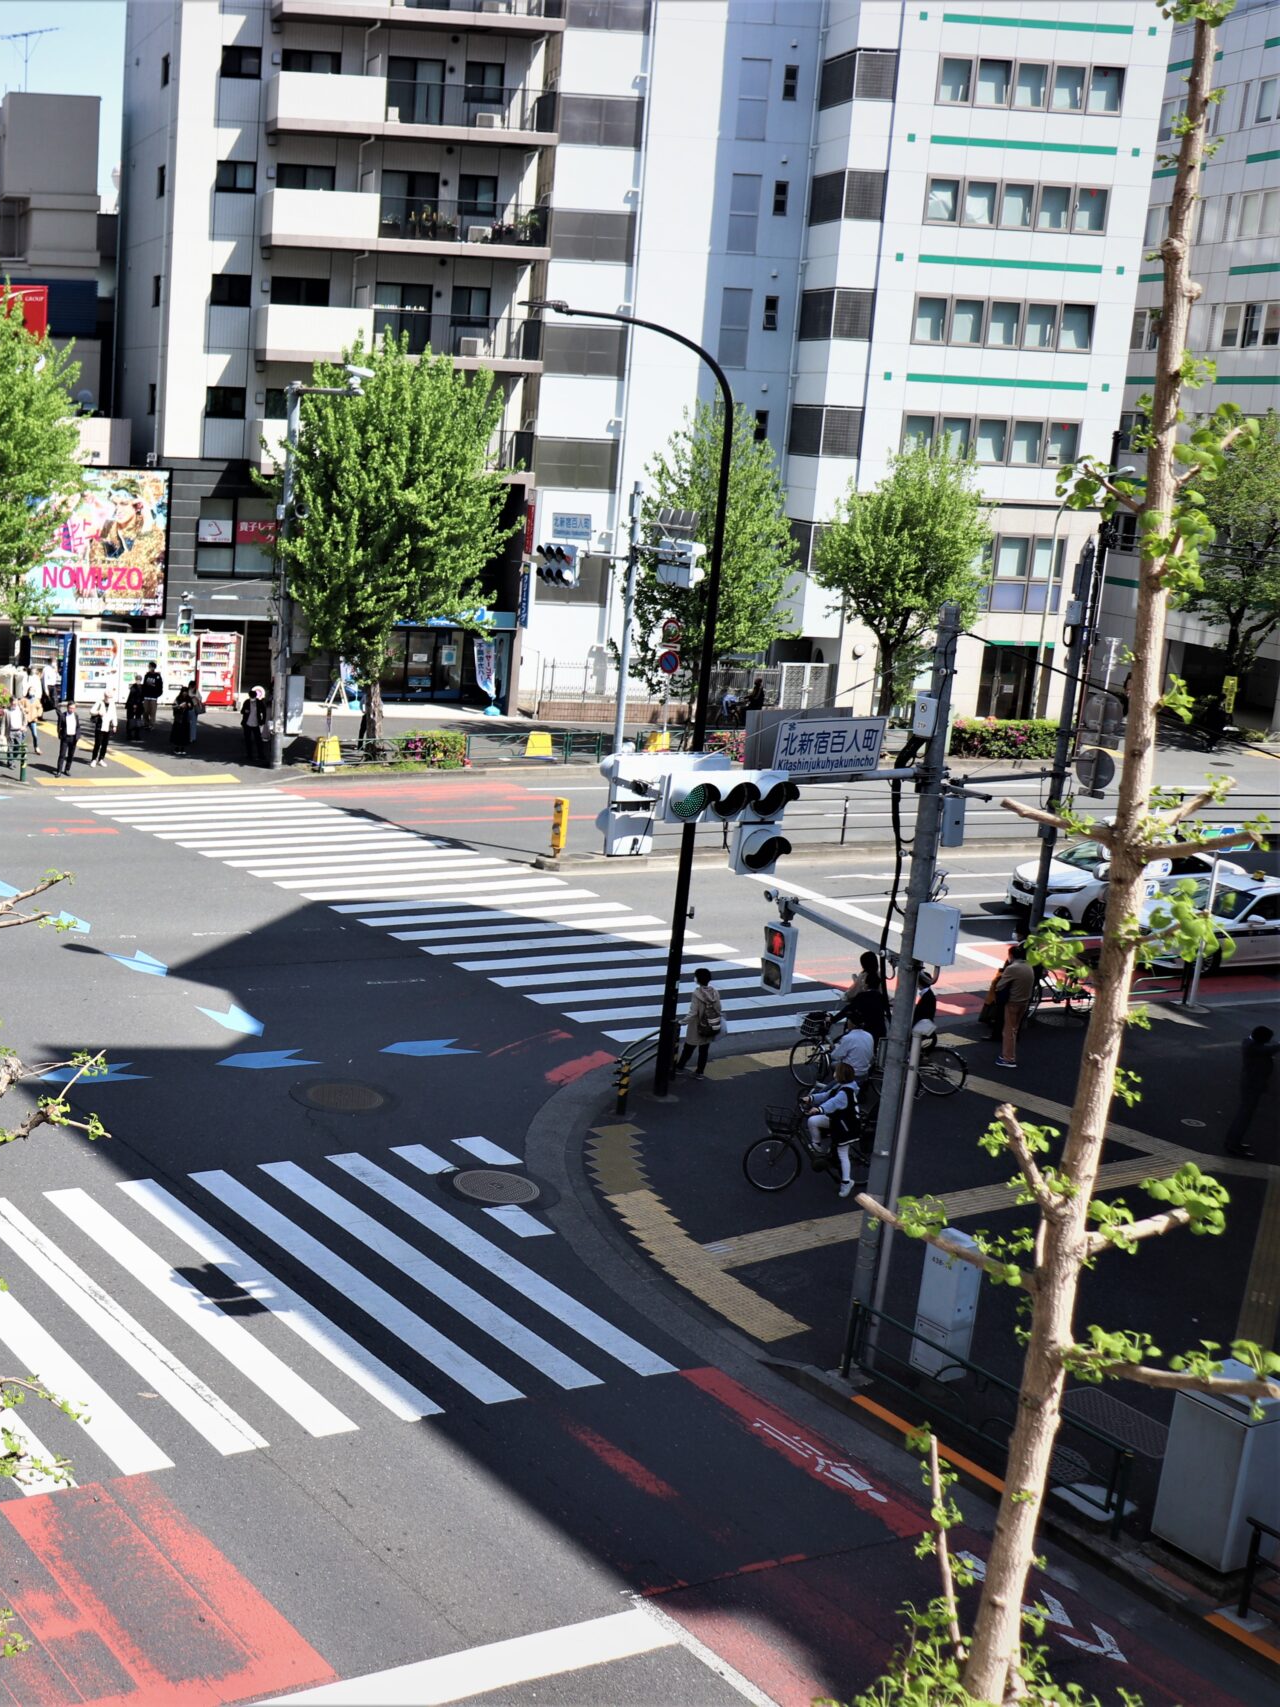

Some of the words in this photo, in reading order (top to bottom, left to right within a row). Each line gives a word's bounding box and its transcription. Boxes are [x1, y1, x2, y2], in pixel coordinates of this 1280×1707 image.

[239, 521, 276, 532] 貴子レデ
[553, 517, 590, 530] 北新宿百人町
[42, 566, 143, 591] NOMUZO
[780, 729, 880, 757] 北新宿百人町
[777, 754, 874, 772] Kitashinjukuhyakunincho
